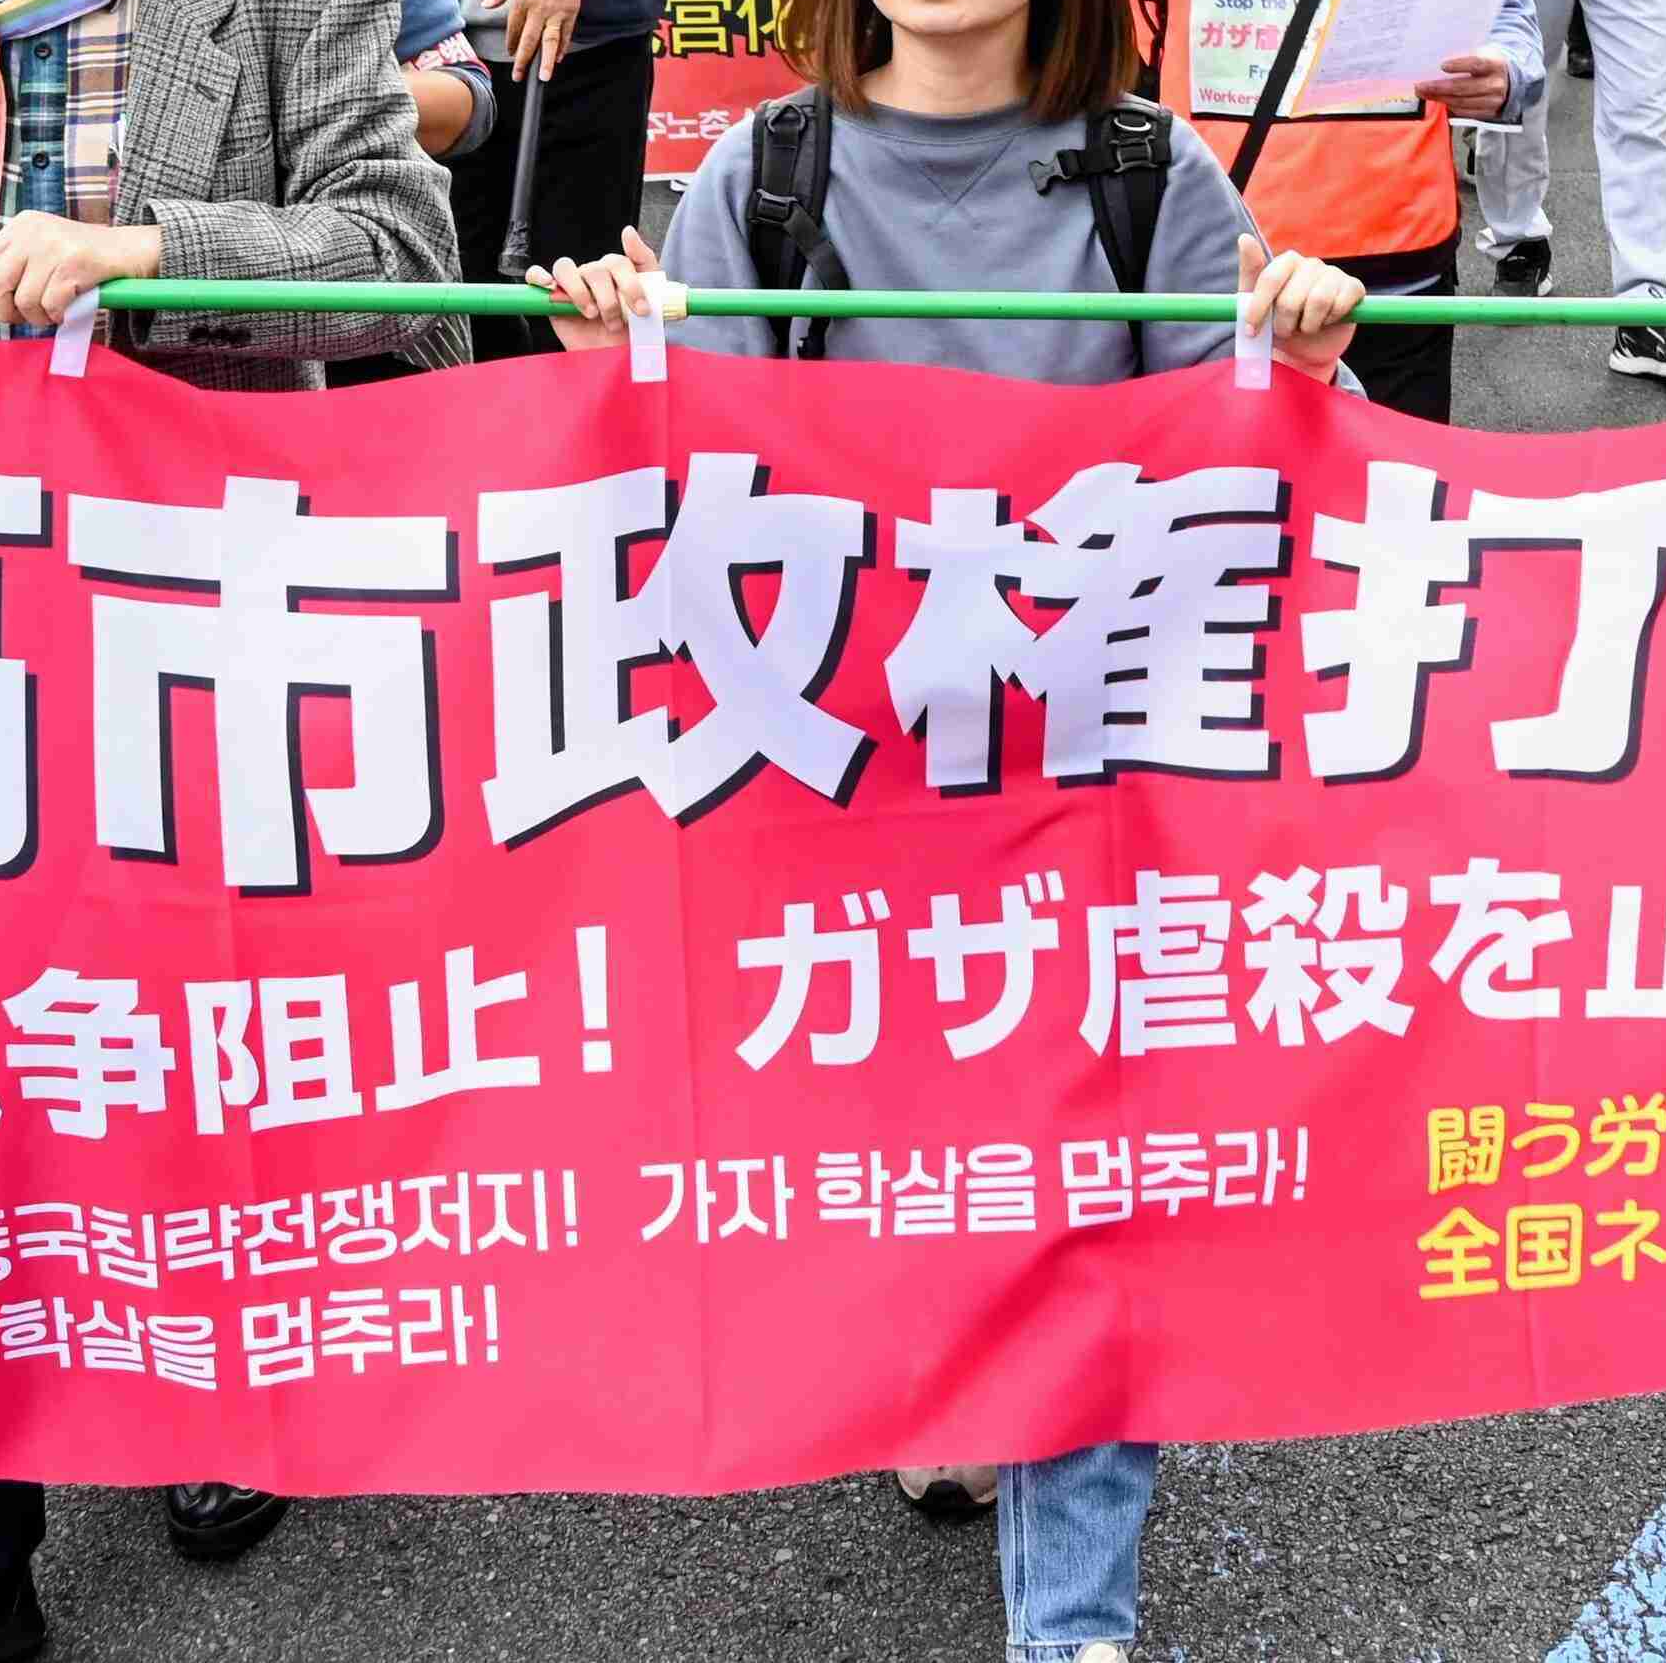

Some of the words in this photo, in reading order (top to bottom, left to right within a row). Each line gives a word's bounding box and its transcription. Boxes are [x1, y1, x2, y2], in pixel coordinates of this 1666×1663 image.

[639, 1155, 795, 1245] 가자
[813, 1141, 1037, 1239] 학살을
[1061, 1126, 1310, 1229] 멈추라!
[239, 1284, 500, 1389] 멈추라!
